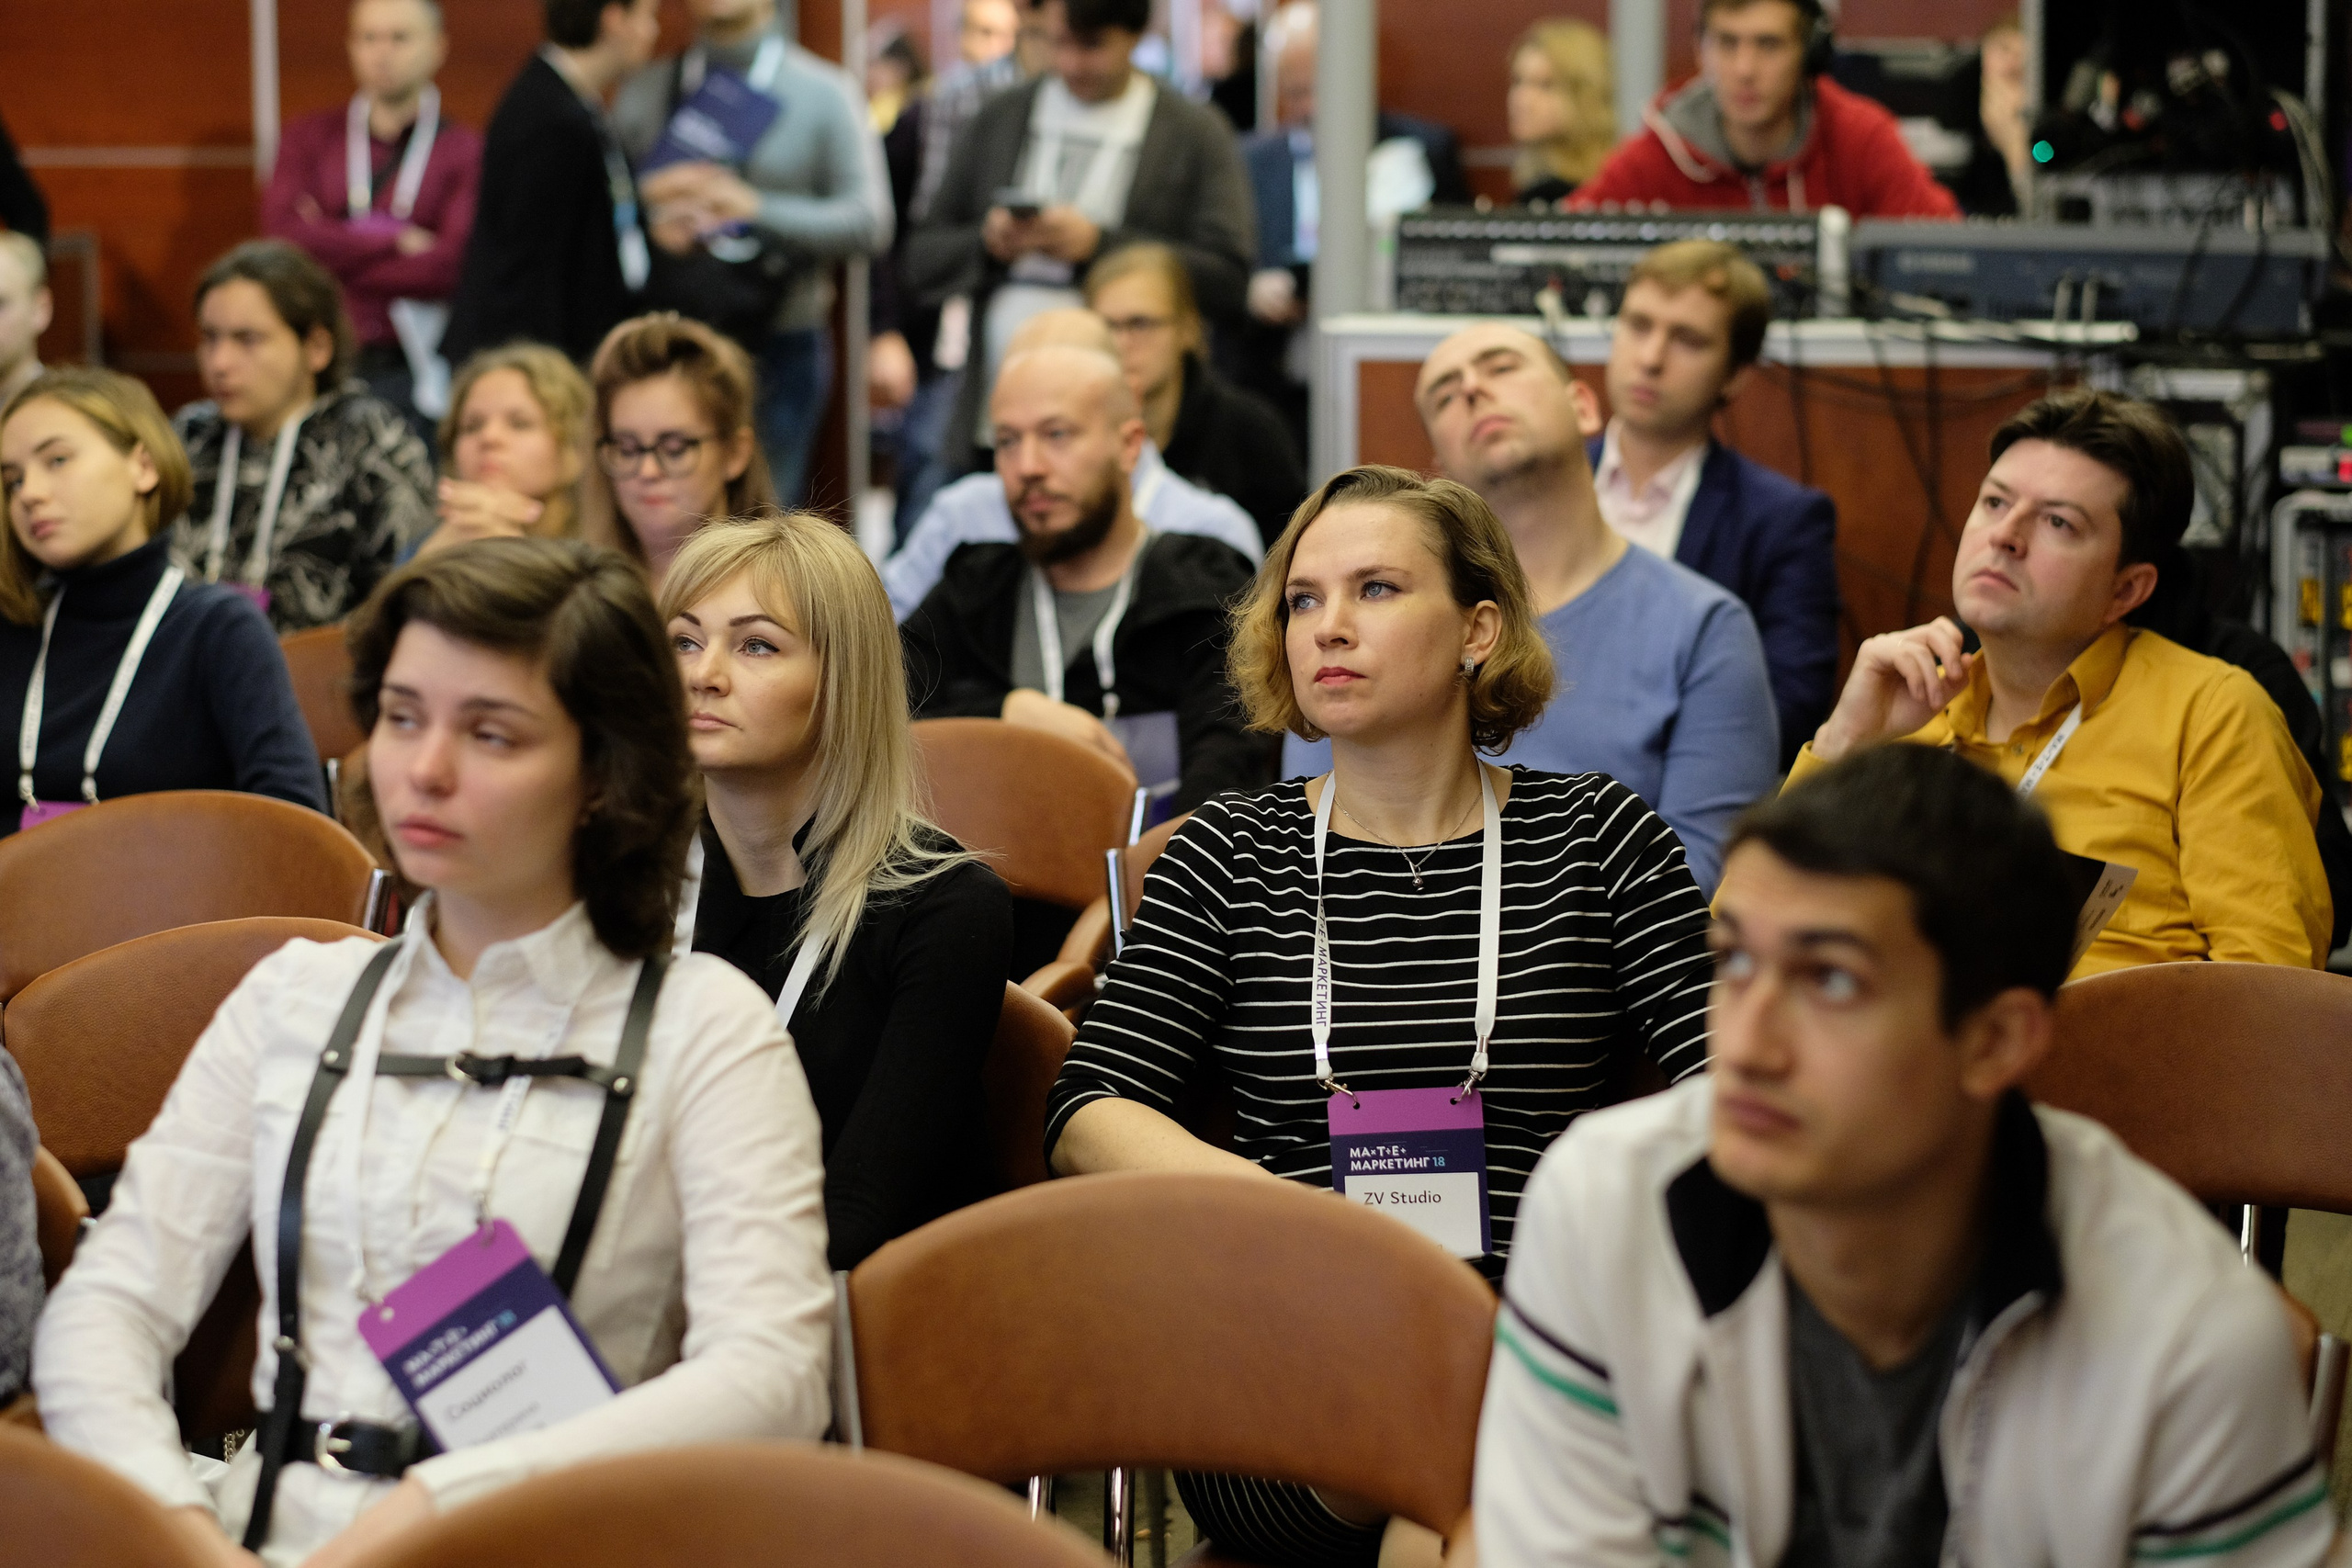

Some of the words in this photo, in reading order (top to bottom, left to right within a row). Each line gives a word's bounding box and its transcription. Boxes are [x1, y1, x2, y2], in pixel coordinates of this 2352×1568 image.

[1316, 945, 1329, 1027] МАРКЕТИНГ
[1351, 1156, 1430, 1171] МАРКЕТИНГ
[1431, 1156, 1446, 1167] 18
[1363, 1191, 1385, 1205] ZV
[1390, 1190, 1442, 1204] Studio
